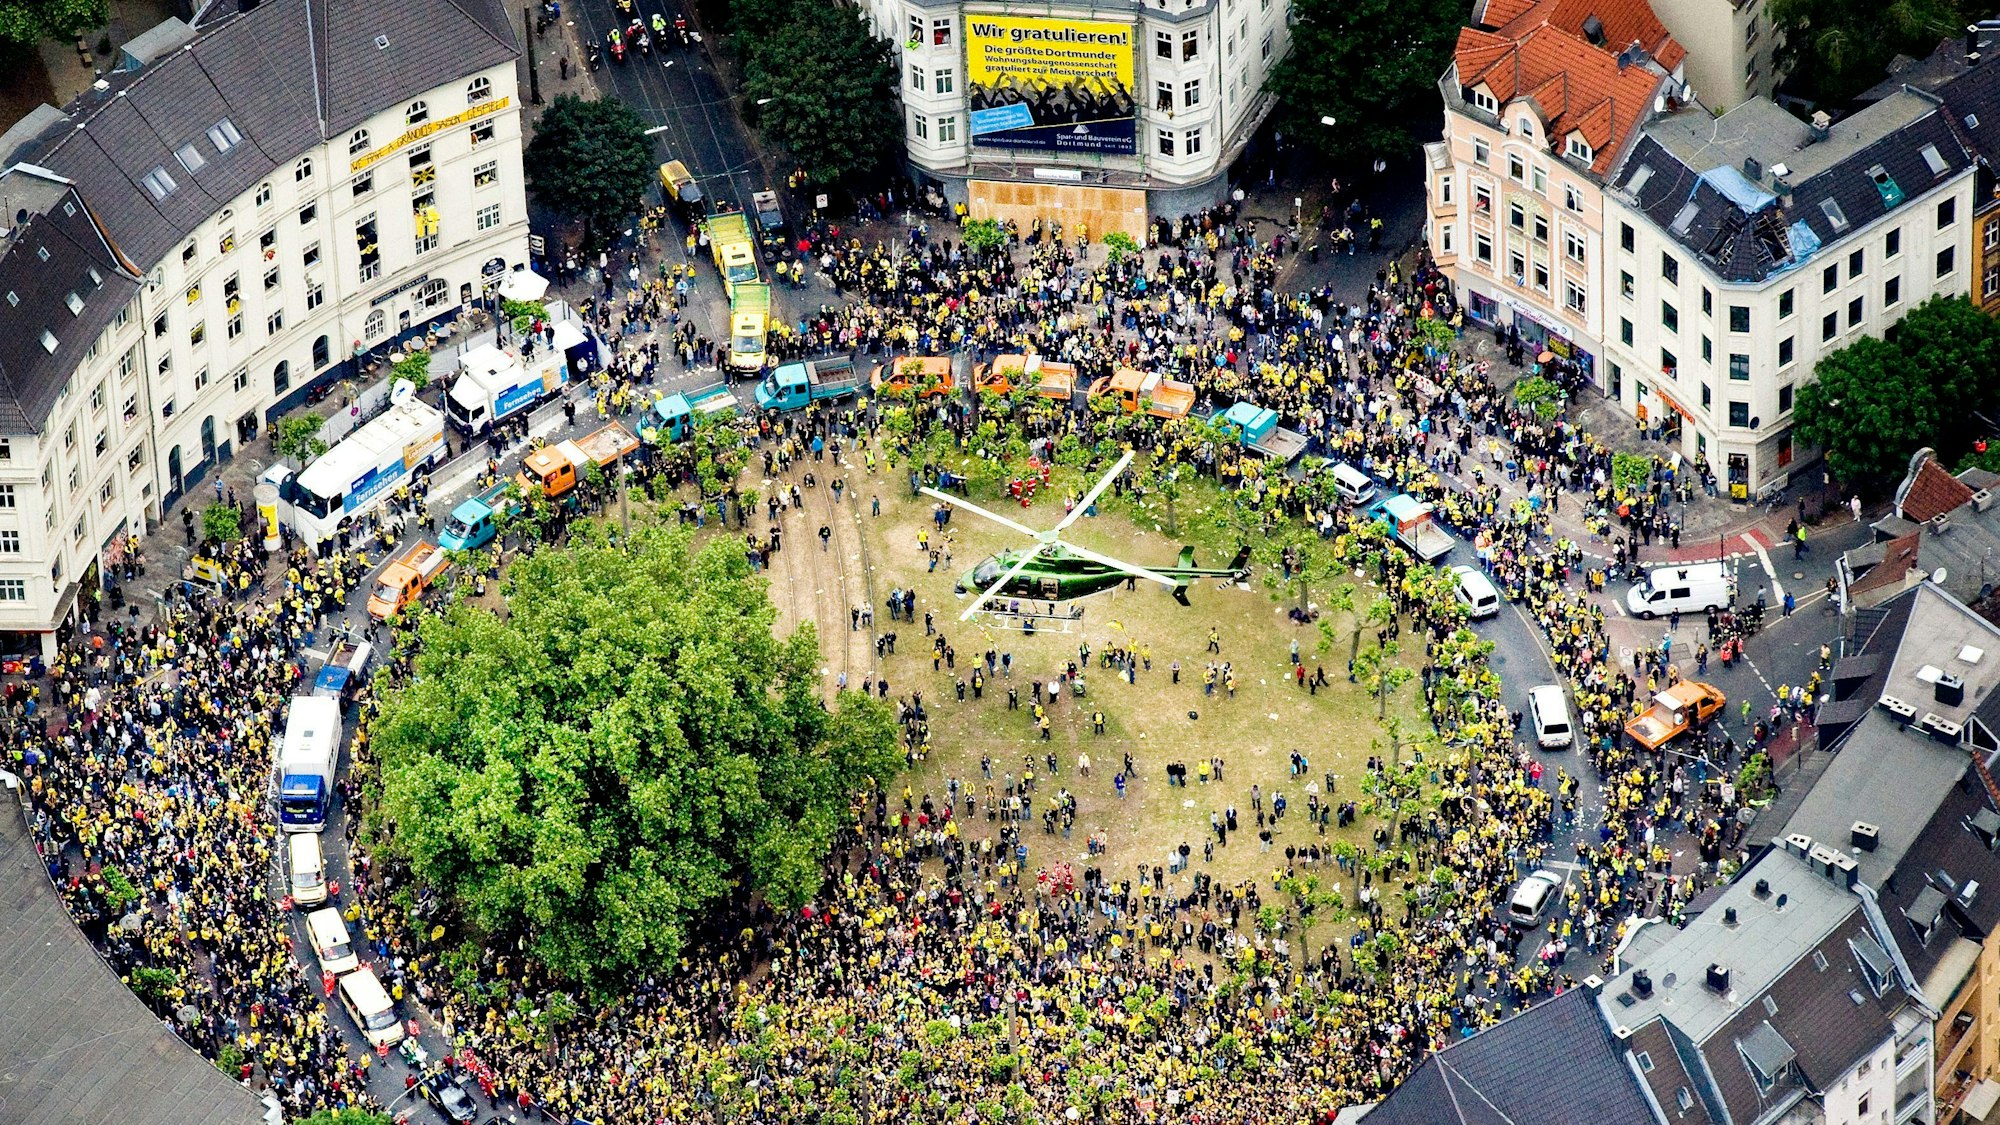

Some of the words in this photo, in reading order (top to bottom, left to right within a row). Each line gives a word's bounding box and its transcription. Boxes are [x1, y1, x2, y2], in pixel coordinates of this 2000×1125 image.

[972, 23, 1006, 38] Wir
[1010, 28, 1128, 45] gratulieren!
[984, 44, 1003, 53] Die
[1005, 46, 1044, 57] größte
[1045, 48, 1117, 60] Dortmunder
[984, 55, 1117, 69] Wohnungsbaugenossenschaft
[985, 64, 1030, 73] gratuliert
[1049, 67, 1117, 77] Meisterschaft!
[1056, 140, 1102, 148] Dortmund
[503, 387, 541, 410] Fernsehen
[355, 471, 398, 504] Fernsehen
